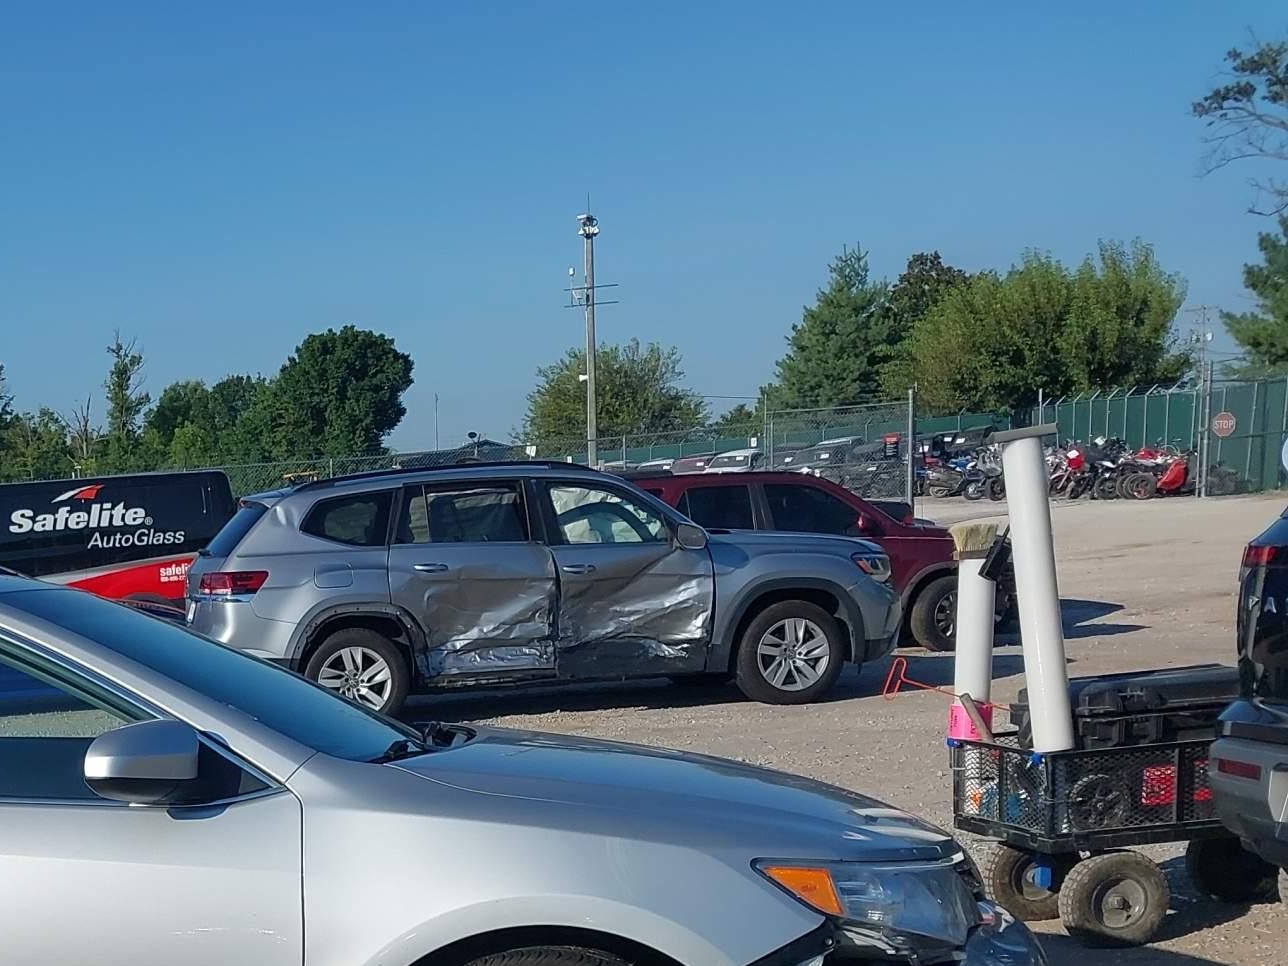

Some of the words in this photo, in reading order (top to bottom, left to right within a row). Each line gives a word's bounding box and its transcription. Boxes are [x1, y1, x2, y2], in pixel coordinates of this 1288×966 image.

[1215, 420, 1234, 430] STOP
[87, 529, 185, 549] AutoGlass
[160, 563, 189, 576] safeli
[1248, 595, 1288, 615] PA
